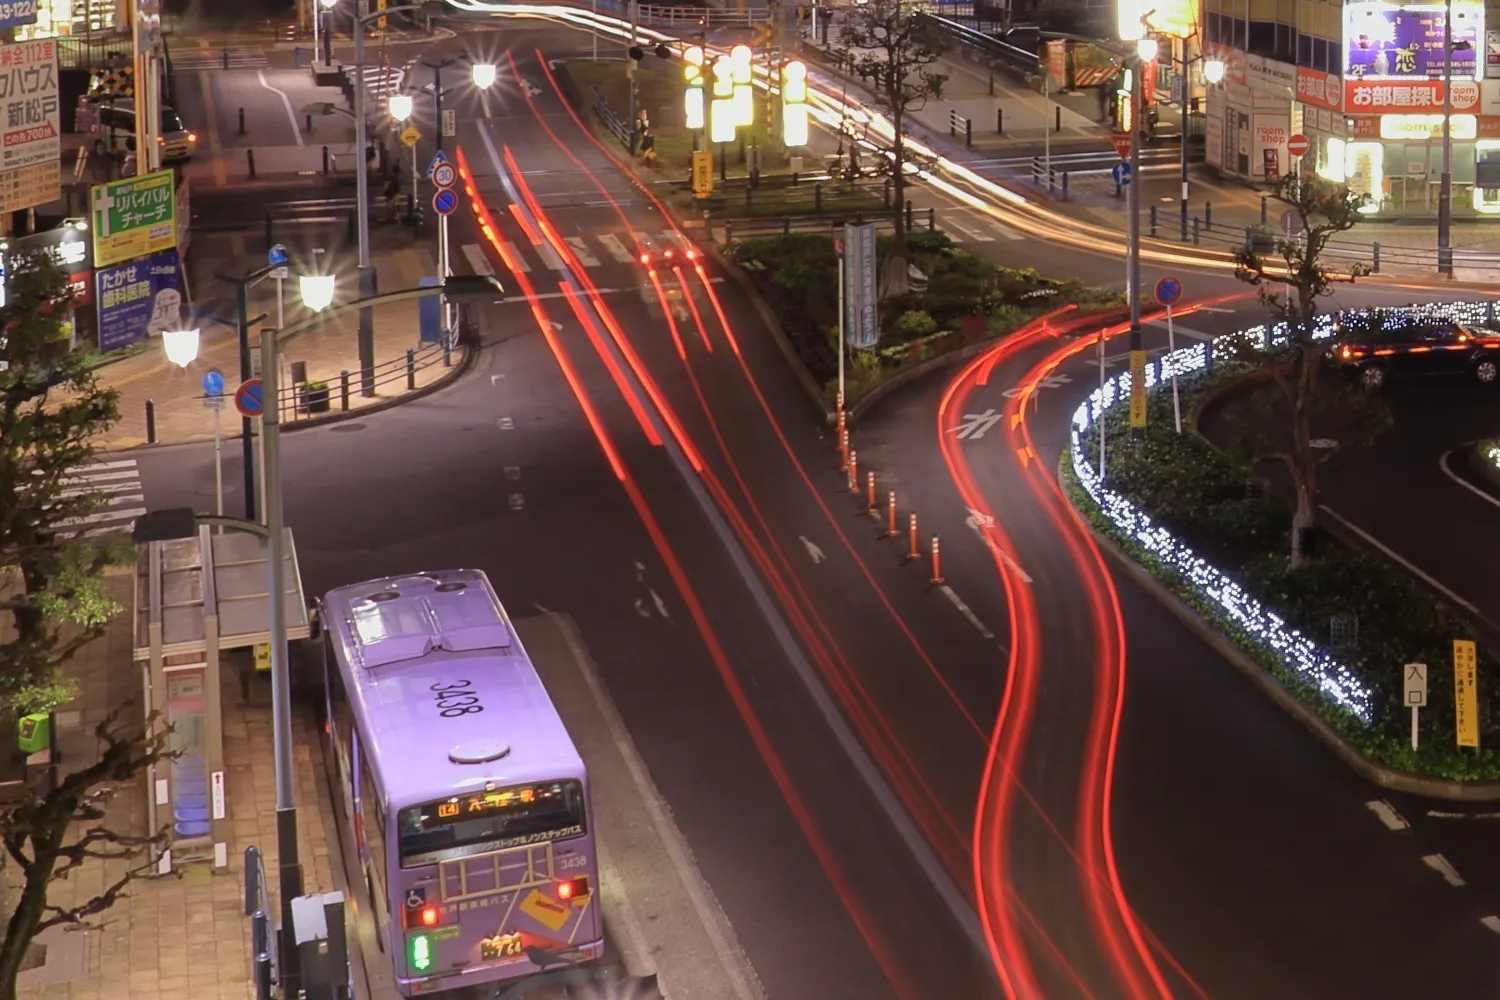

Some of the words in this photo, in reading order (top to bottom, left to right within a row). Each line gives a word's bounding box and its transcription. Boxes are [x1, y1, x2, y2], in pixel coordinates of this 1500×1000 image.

[1352, 64, 1367, 76] 2F
[1395, 47, 1416, 73] 恋
[1352, 85, 1445, 107] お部屋探し
[1452, 93, 1477, 103] shop
[7, 95, 58, 127] 新松戸
[1256, 126, 1284, 135] room
[1261, 134, 1286, 146] shop
[116, 187, 170, 213] リバイバル
[122, 204, 166, 229] チャーチ
[102, 265, 138, 290] たかせ
[102, 280, 151, 309] 歯科医院
[1408, 665, 1424, 704] 入口
[430, 679, 484, 718] 3438
[560, 855, 587, 870] 3438
